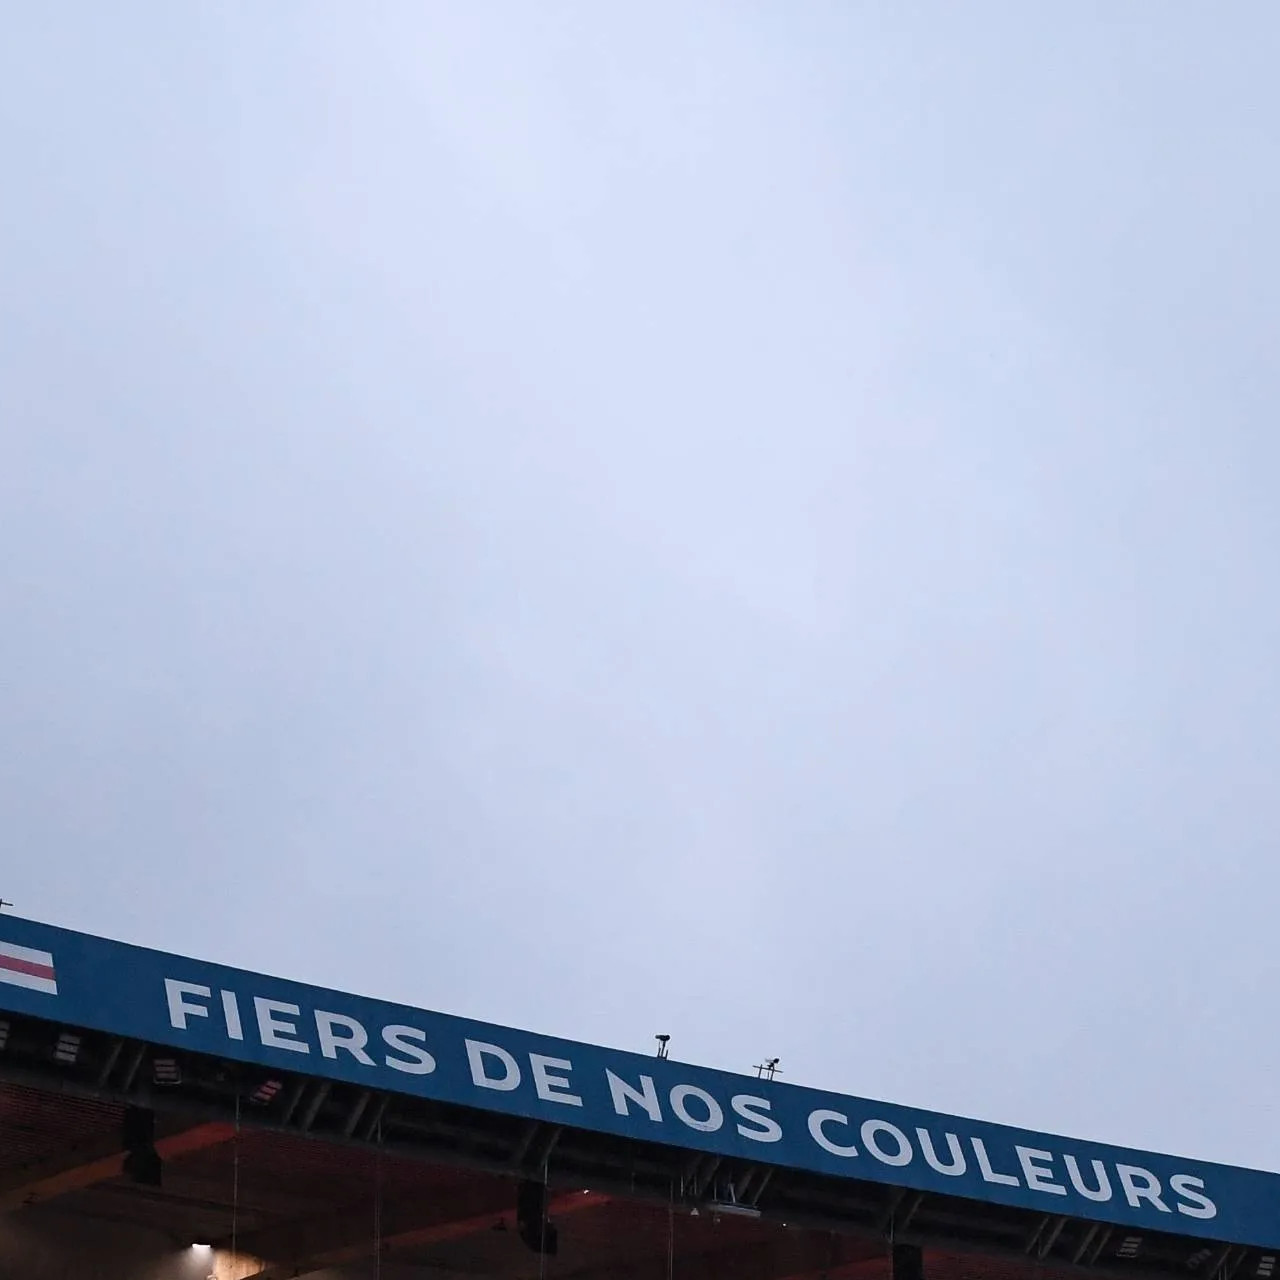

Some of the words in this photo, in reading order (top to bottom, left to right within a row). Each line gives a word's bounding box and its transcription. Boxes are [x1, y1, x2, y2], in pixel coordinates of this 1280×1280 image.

[164, 978, 436, 1075] FIERS
[464, 1038, 583, 1107] DE
[606, 1068, 783, 1143] NOS
[807, 1109, 1217, 1219] COULEURS
